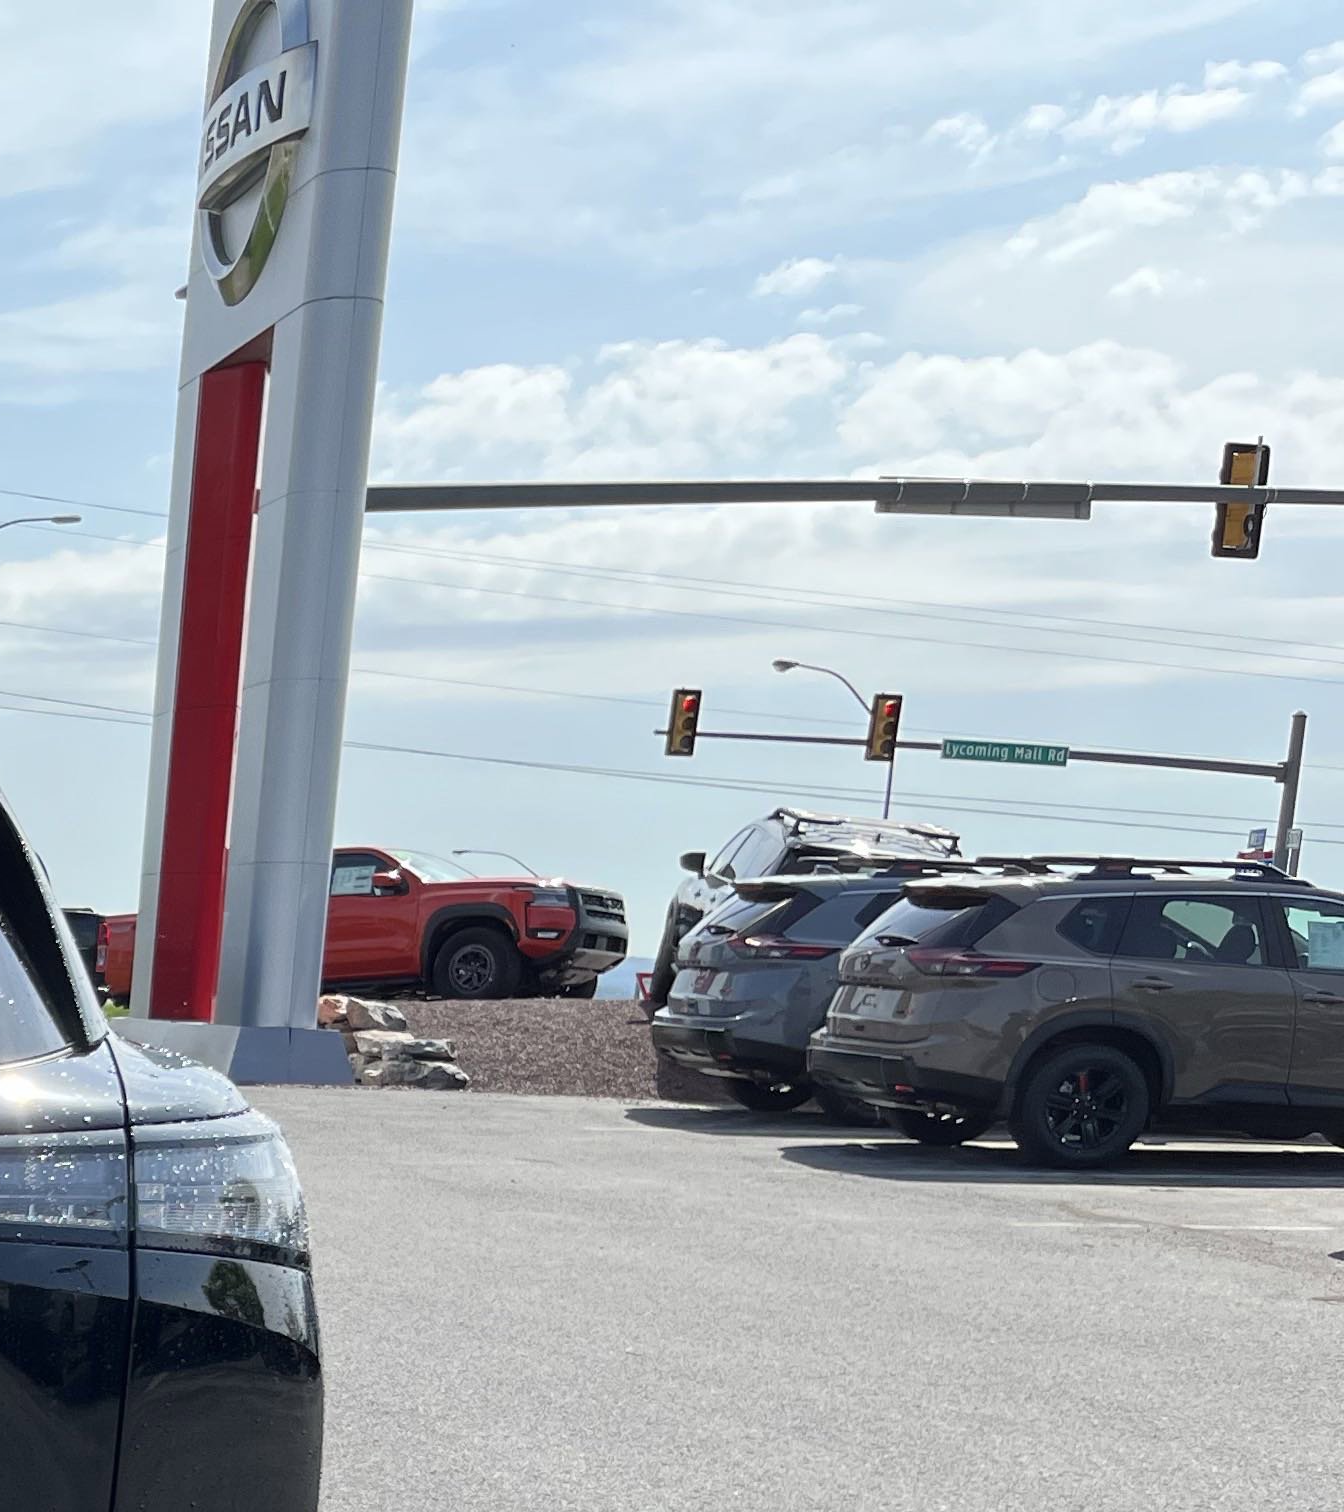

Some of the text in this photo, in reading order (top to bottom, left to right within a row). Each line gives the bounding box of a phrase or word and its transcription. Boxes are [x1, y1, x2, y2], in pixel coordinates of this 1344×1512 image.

[204, 70, 287, 173] SSAN
[945, 742, 1065, 762] Lycoming Mall Rd
